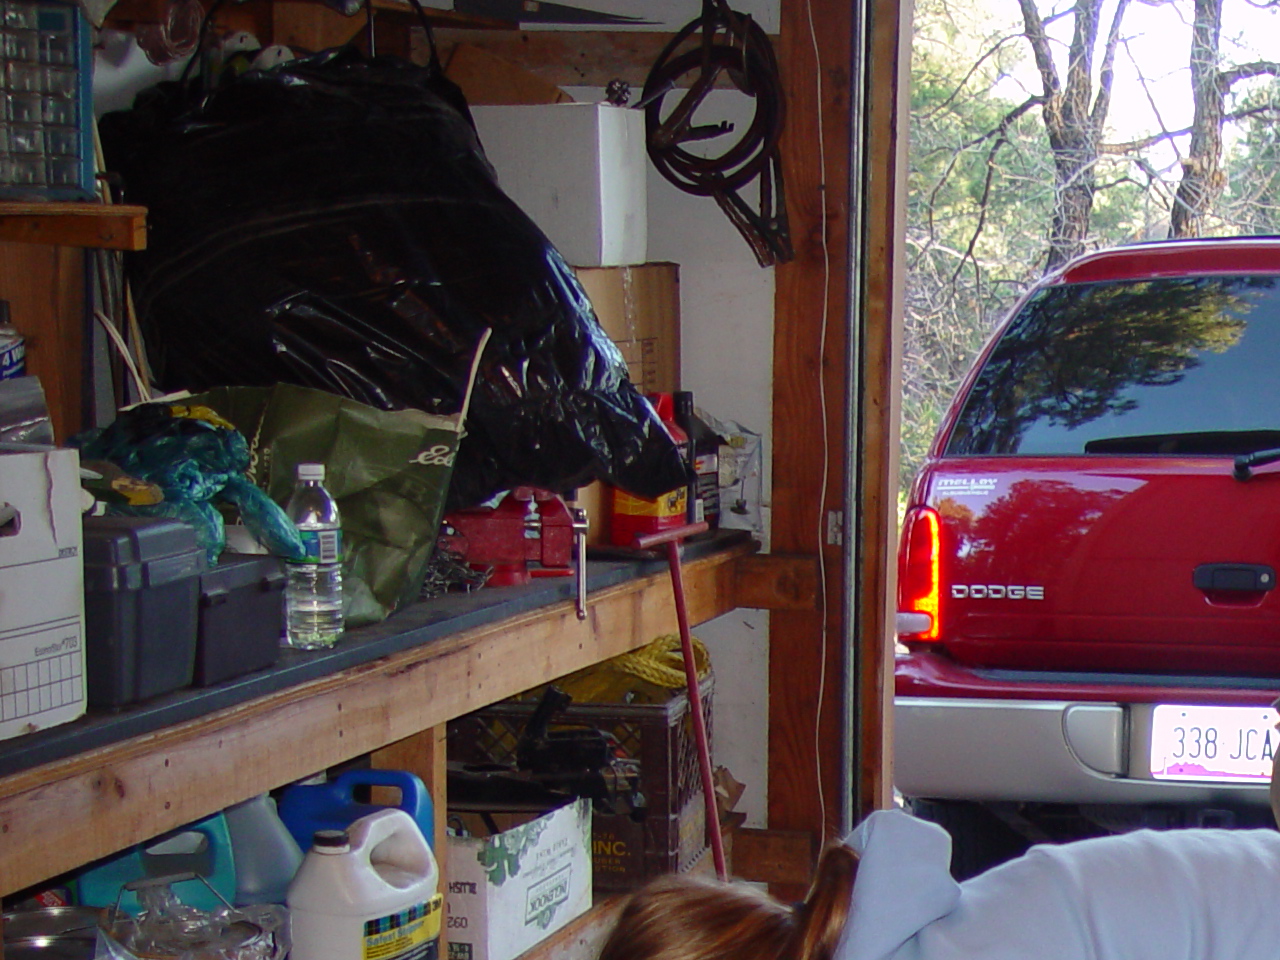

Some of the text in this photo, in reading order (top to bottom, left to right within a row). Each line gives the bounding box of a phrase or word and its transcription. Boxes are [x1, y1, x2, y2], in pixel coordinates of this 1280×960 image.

[951, 584, 1045, 600] DODGE
[1172, 726, 1274, 761] 338 JCA
[593, 840, 631, 857] INC.
